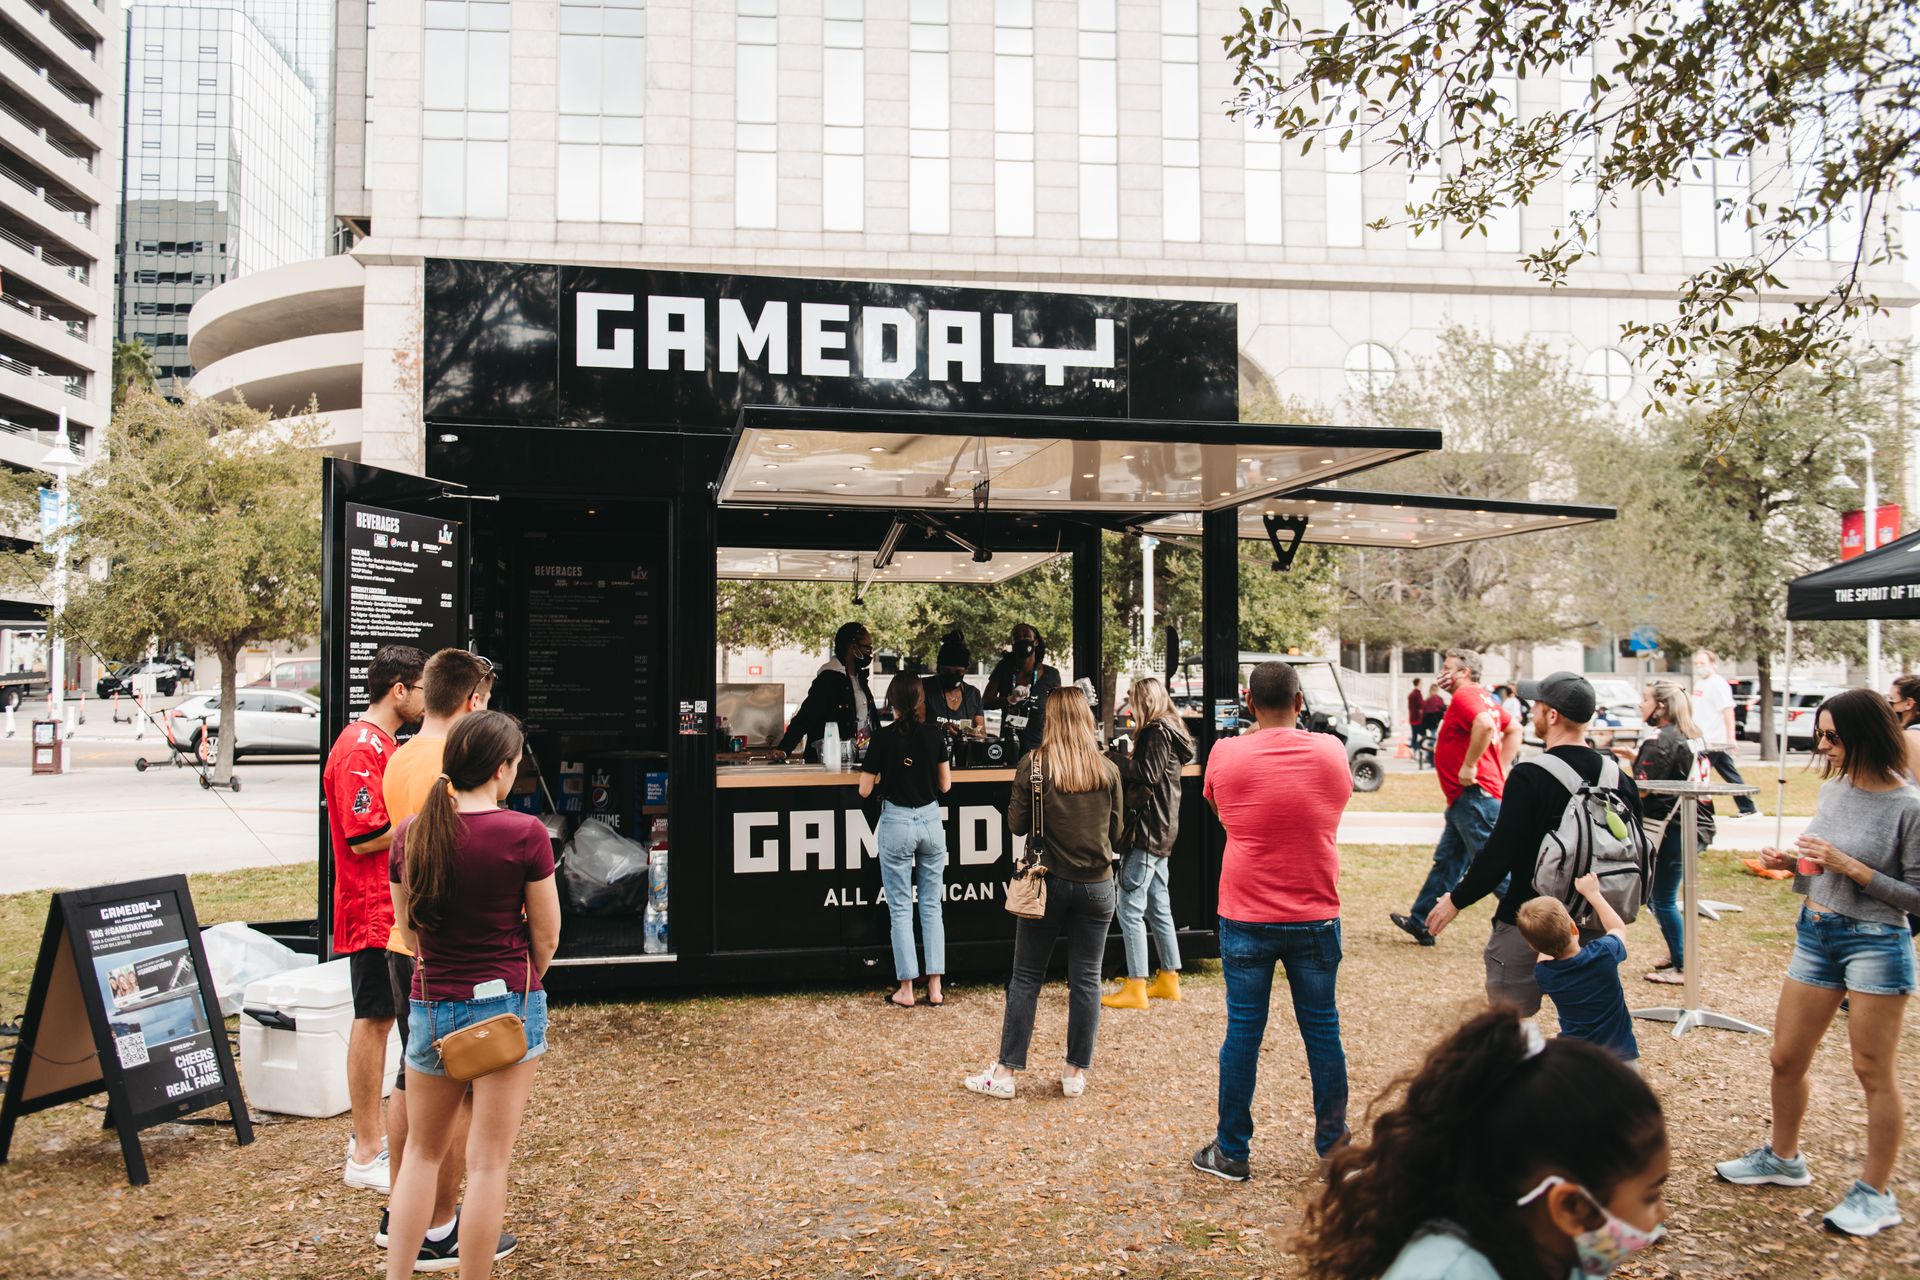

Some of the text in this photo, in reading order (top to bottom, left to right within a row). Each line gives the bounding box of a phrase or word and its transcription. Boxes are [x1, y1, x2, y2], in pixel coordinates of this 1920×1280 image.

[576, 291, 1115, 386] GAMEDAY
[1092, 378, 1115, 388] TM
[356, 511, 400, 534] BEVERAGES
[534, 565, 583, 577] BEVERAGES
[1834, 588, 1854, 603] THE
[1855, 586, 1889, 602] SPIRIT
[1890, 585, 1906, 599] OF
[824, 887, 868, 907] ALL
[875, 881, 994, 905] AEICAN
[100, 899, 162, 920] GAMEDAY
[89, 918, 164, 939] TAG #GAMEDAYVODKA
[175, 1047, 215, 1068] CHEERS
[181, 1059, 218, 1079] TO THE
[166, 1071, 221, 1098] REAL FANS
